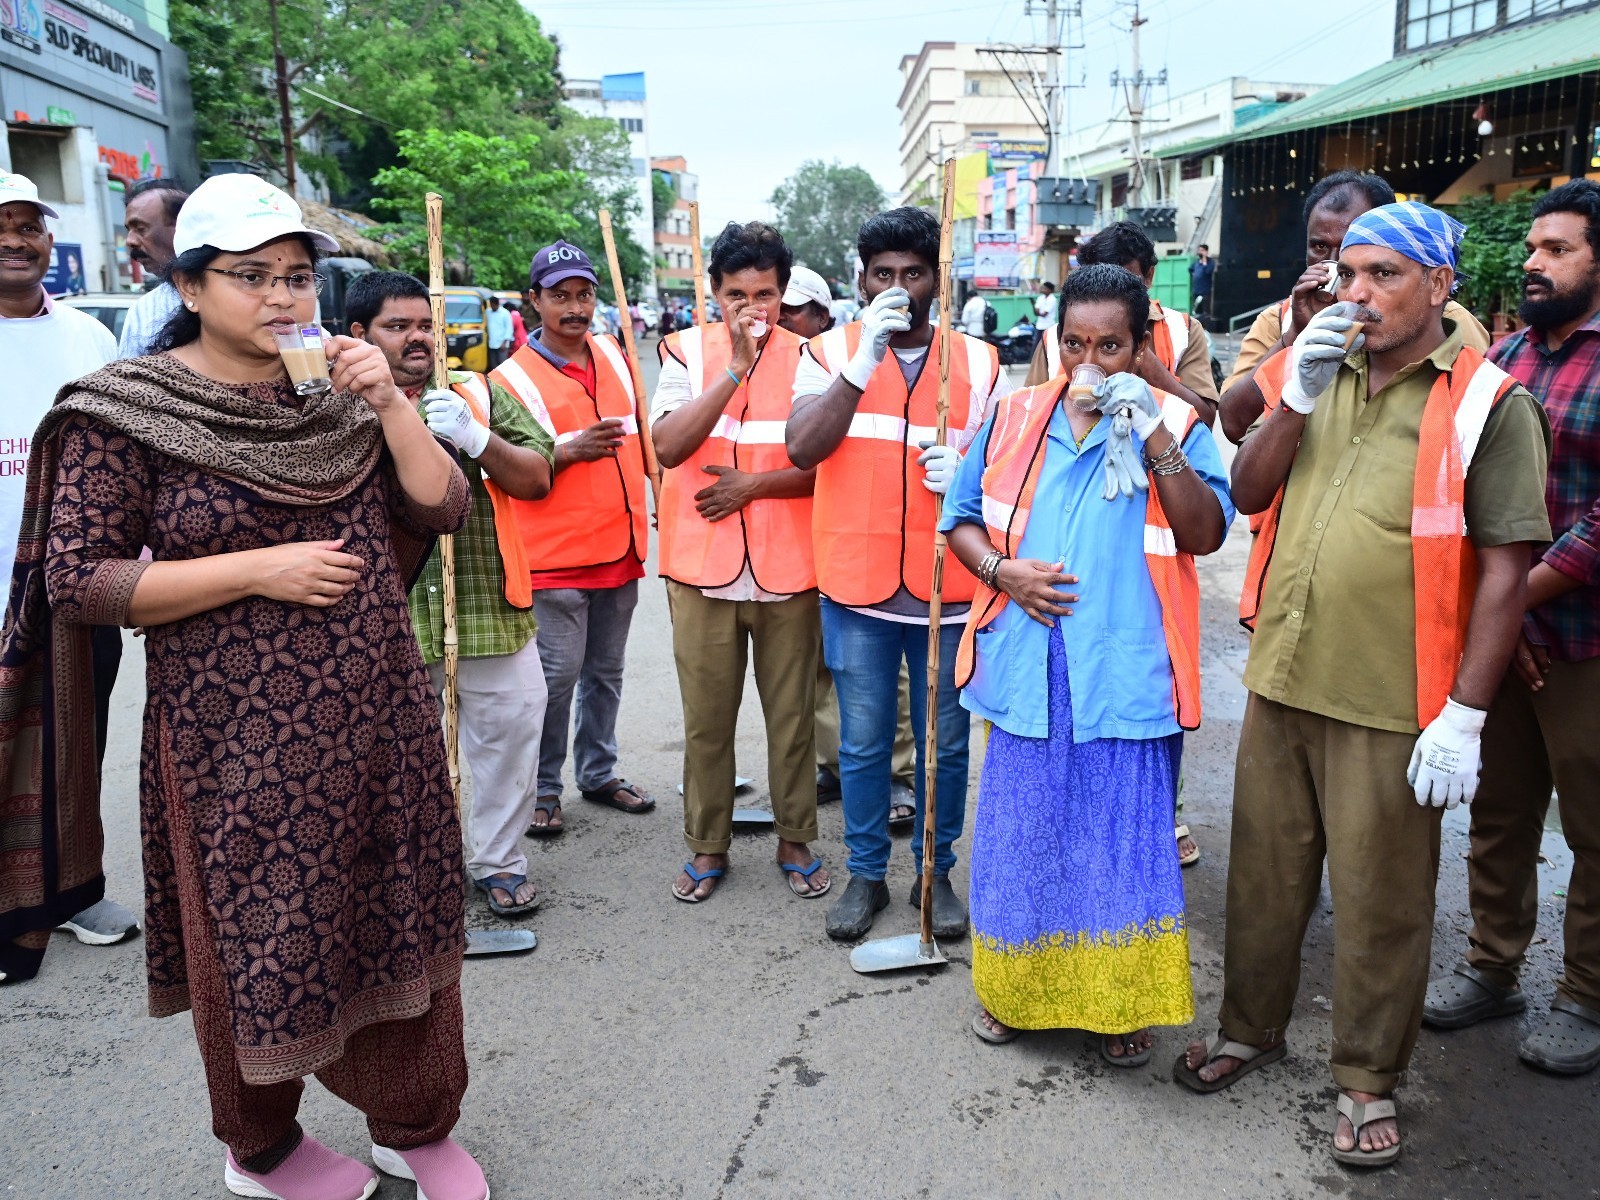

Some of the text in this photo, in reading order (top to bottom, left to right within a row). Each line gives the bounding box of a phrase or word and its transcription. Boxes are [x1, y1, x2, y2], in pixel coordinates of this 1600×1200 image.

[45, 19, 69, 50] SLD
[548, 247, 581, 264] BOY
[0, 459, 30, 476] OR
